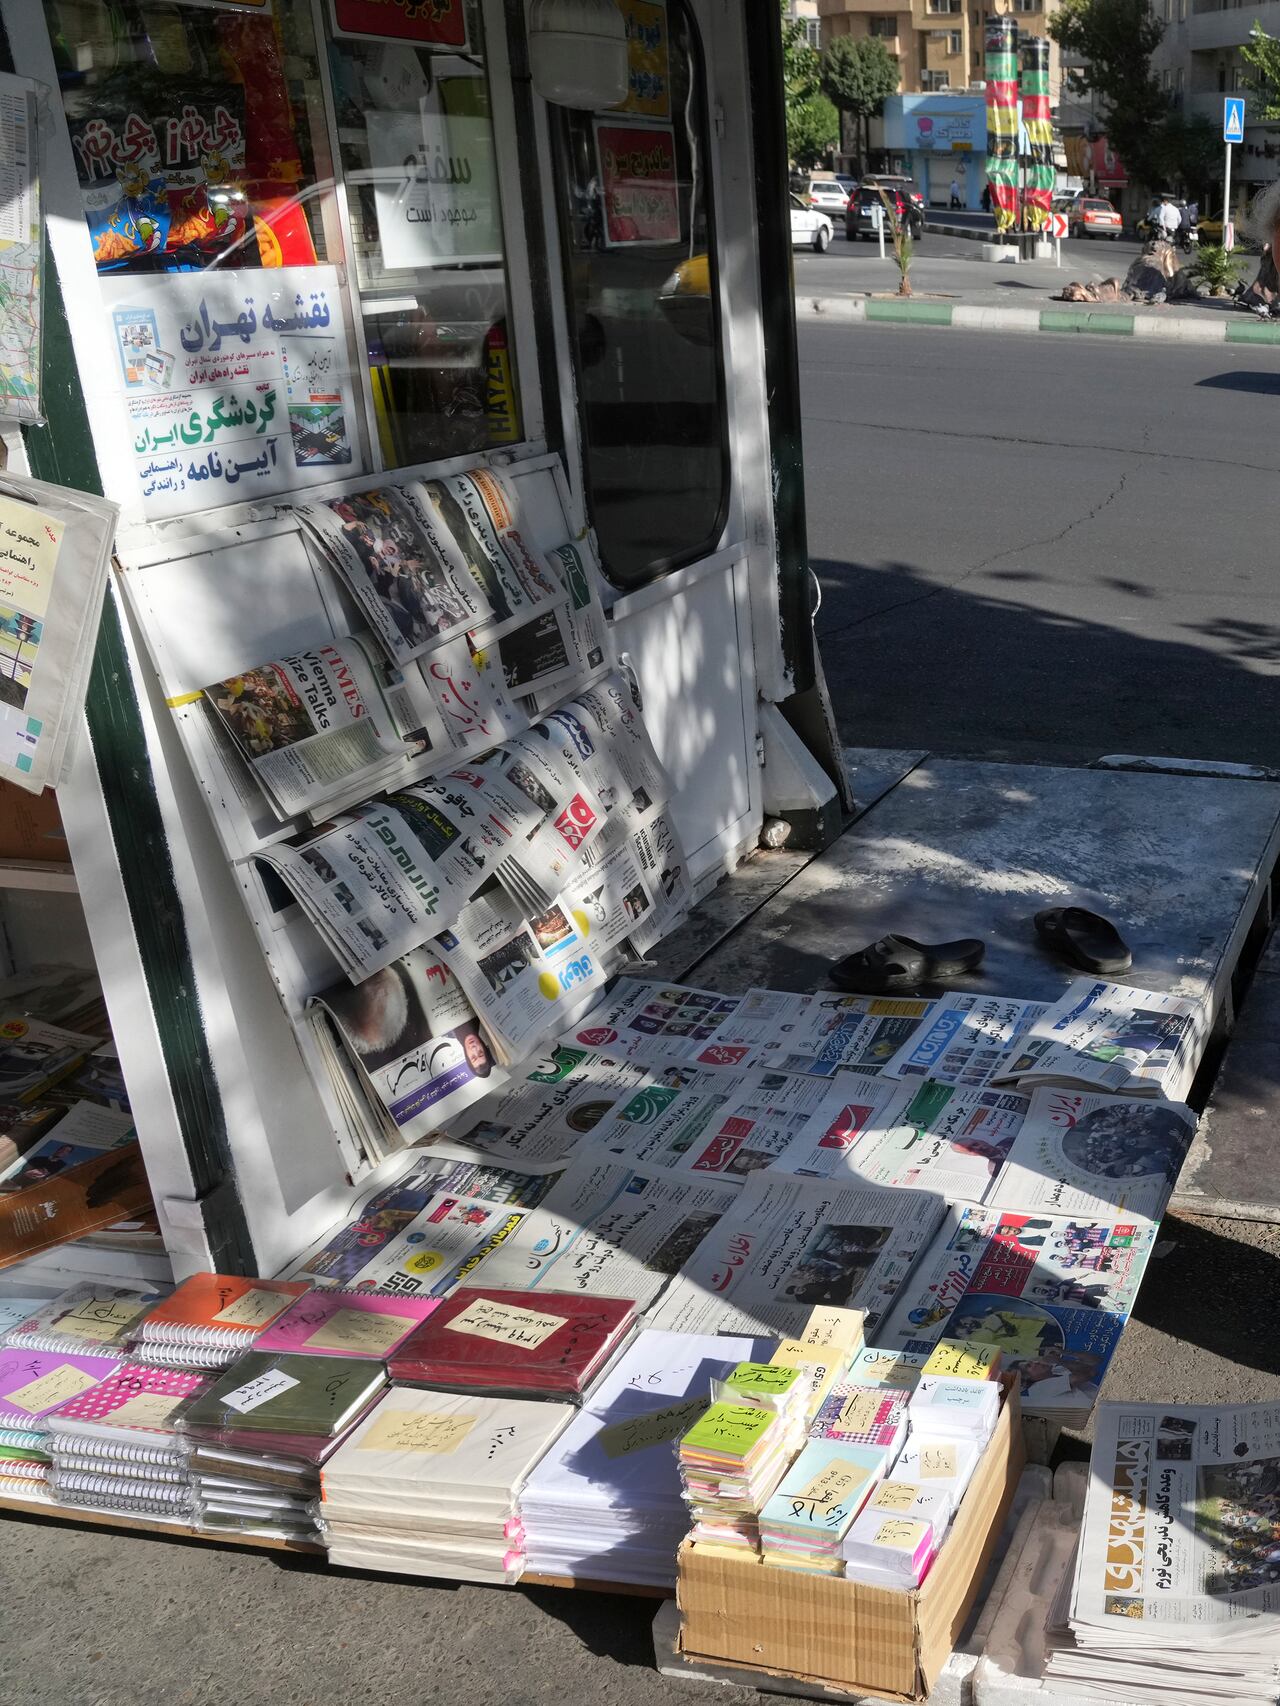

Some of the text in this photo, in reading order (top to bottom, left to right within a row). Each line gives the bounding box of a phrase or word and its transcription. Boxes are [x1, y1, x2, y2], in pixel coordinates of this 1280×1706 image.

[406, 206, 478, 226] موجود است
[180, 292, 331, 353] نقشه تهران
[189, 371, 208, 385] ایران
[233, 365, 250, 377] نقشه
[180, 390, 277, 445] گردشگری
[134, 423, 179, 453] ایران
[139, 458, 183, 479] راهنمایی
[143, 478, 178, 497] رانندگی
[5, 528, 41, 547] مجموعه
[462, 506, 486, 538] پدری
[427, 531, 448, 568] میلیون
[480, 541, 503, 573] میراث
[449, 575, 478, 615] شفافیت
[499, 577, 523, 604] وقتی
[304, 652, 336, 707] Vienna
[321, 648, 364, 717] TIMES
[305, 685, 329, 729] Talks
[555, 801, 601, 846] جوان
[344, 831, 368, 855] خودرو
[368, 817, 414, 876] امروز
[365, 855, 387, 886] معاملات
[554, 953, 597, 988] الوفاق
[1047, 1094, 1081, 1129] ایران
[489, 1214, 525, 1247] قهرمان
[528, 1219, 568, 1269] کیهان
[711, 1233, 754, 1292] اطلاعات
[508, 1329, 540, 1343] ۱۳۹۹
[1104, 1437, 1151, 1594] همشهری
[1152, 1467, 1175, 1590] وعده کاهش تدریجی تورم
